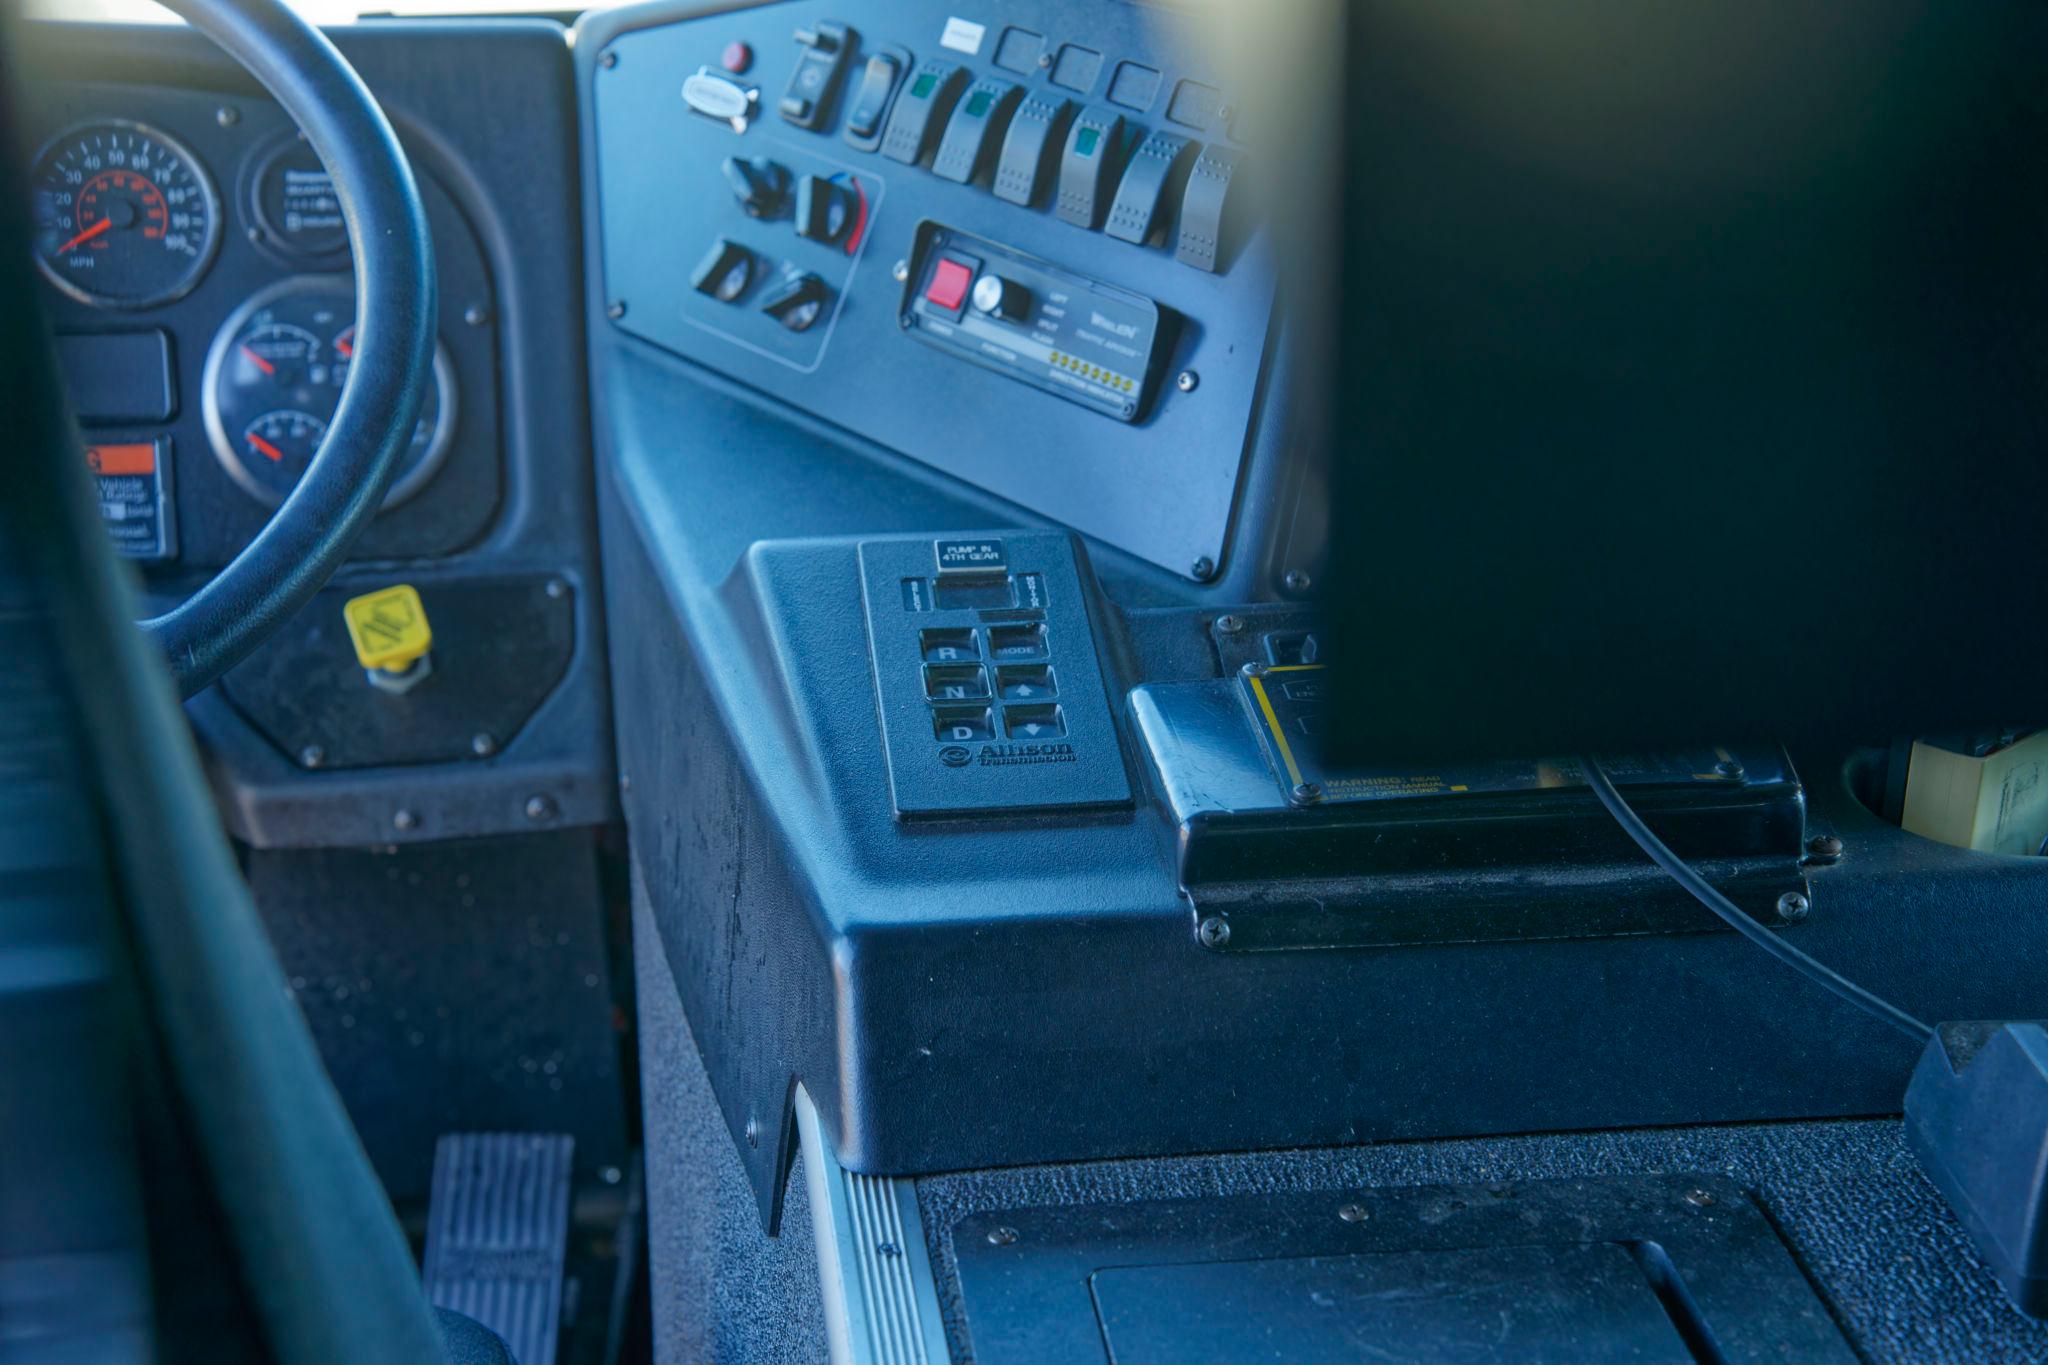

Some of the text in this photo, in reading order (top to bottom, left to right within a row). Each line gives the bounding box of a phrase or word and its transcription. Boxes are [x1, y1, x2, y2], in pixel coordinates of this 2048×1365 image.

[84, 155, 101, 169] 40
[66, 170, 82, 185] 30
[55, 193, 72, 206] 20
[58, 217, 72, 229] 10
[70, 256, 95, 268] MPH
[947, 544, 992, 554] PUMP IN
[942, 552, 999, 561] 4TH GEAR
[938, 647, 958, 660] R
[997, 646, 1036, 656] MODE
[945, 686, 965, 699] N
[953, 726, 974, 740] D
[979, 743, 1074, 757] Allison
